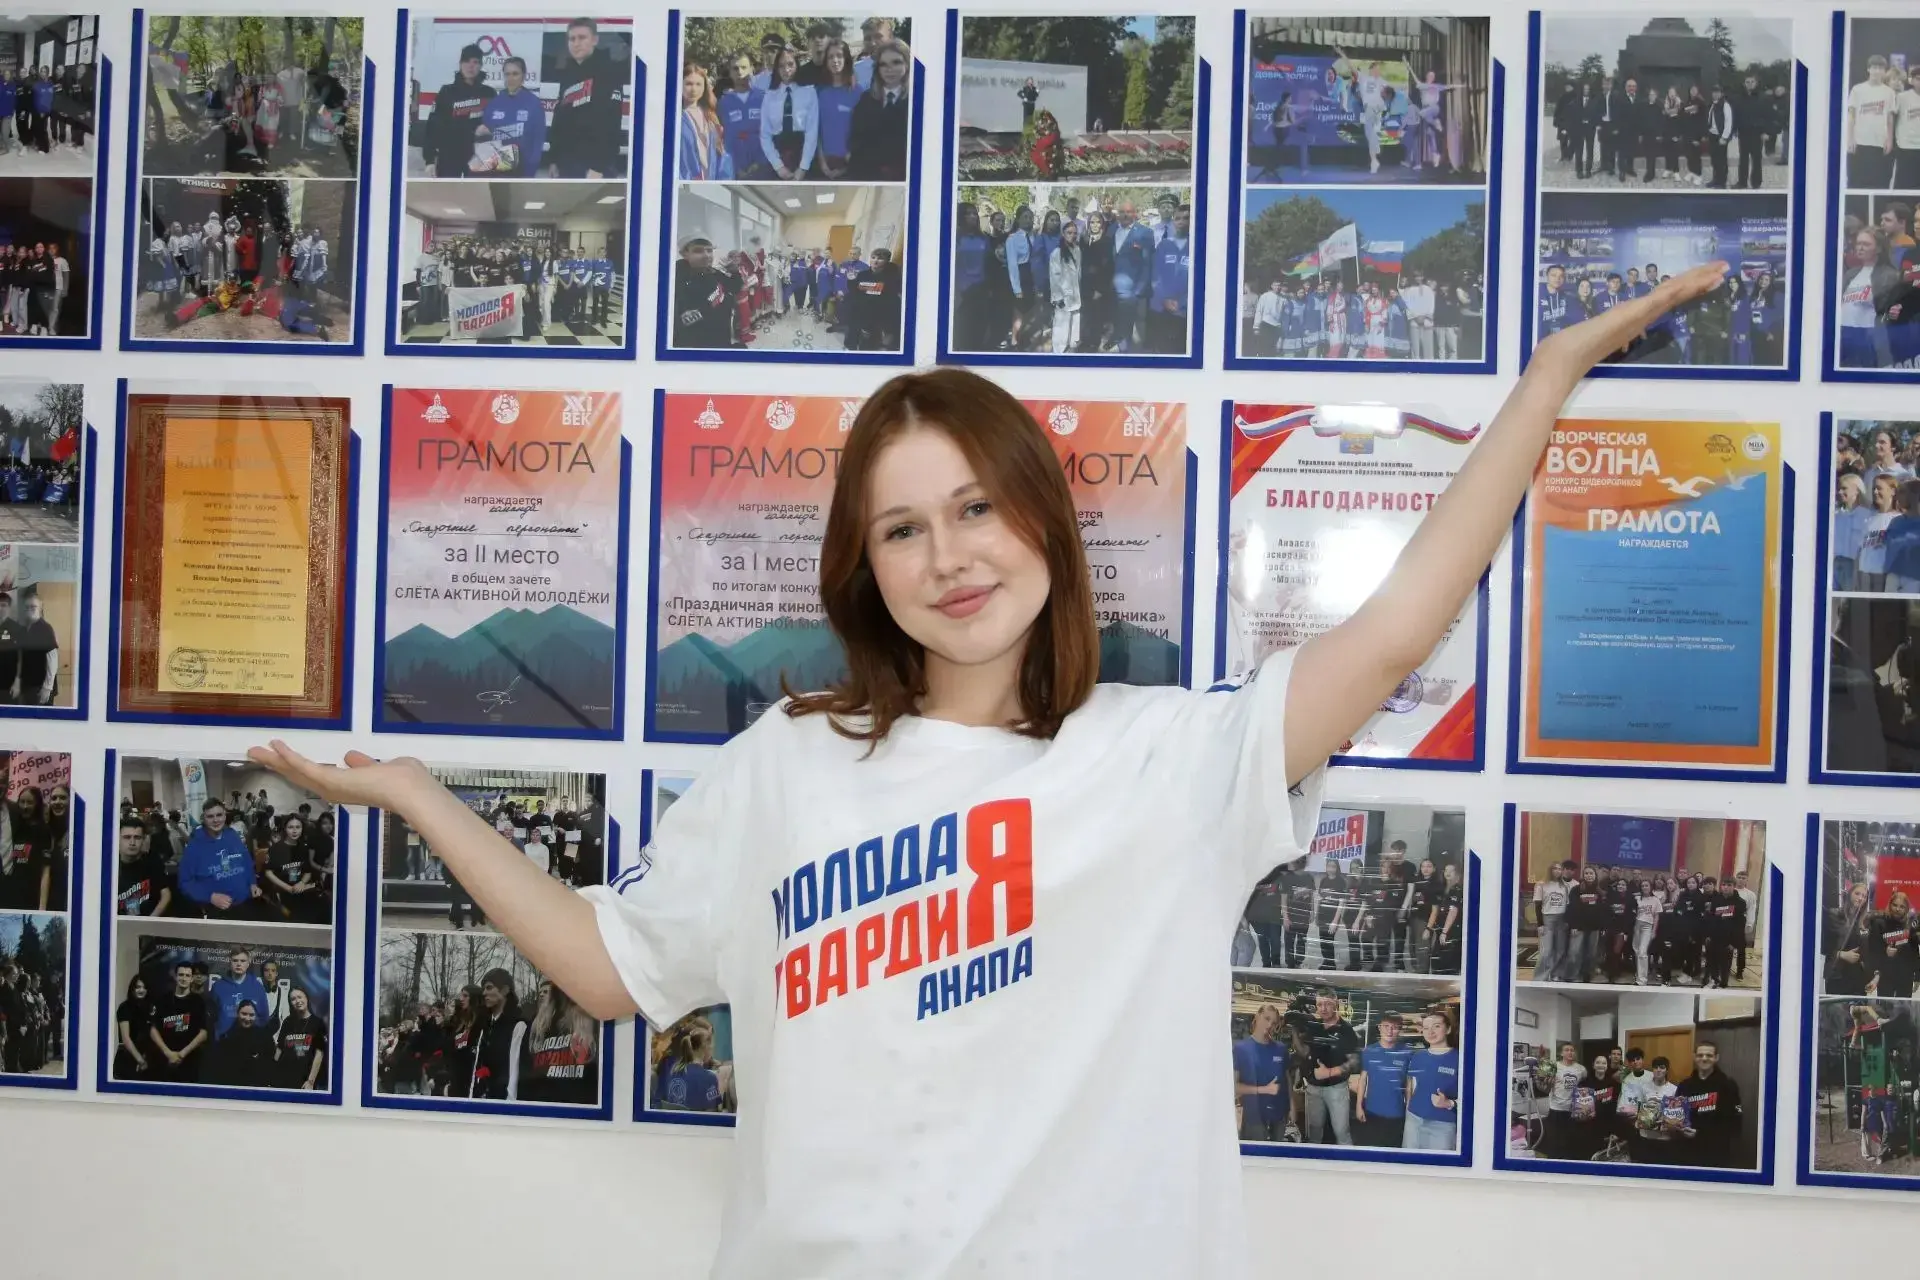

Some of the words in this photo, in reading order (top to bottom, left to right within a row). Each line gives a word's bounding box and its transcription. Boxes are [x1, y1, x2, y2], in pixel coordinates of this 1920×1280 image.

[177, 178, 210, 188] ЕТНИЙ
[211, 182, 227, 190] САД
[562, 411, 592, 426] ВЕК
[1123, 423, 1156, 437] ВЕК
[1550, 430, 1647, 446] ТВОРЧЕСКАЯ
[417, 438, 597, 474] ГРАМОТА
[690, 445, 844, 480] ГРАМОТ
[1546, 446, 1661, 476] ВОЛНА
[1063, 451, 1159, 486] МОТА
[1545, 476, 1580, 486] КОНКУРС
[1580, 478, 1642, 487] ВИДЕОРОЛИКОВ
[1545, 486, 1562, 494] ПРО
[1563, 487, 1589, 495] АНАПУ
[463, 495, 543, 506] награждается
[1266, 488, 1439, 512] БЛАГОДАРНОСТ
[738, 503, 819, 514] награждается
[1588, 508, 1721, 534] ГРАМОТА
[1618, 539, 1690, 550] НАГРАЖДАЕТСЯ
[444, 547, 468, 563] за
[494, 549, 560, 565] место
[721, 554, 745, 571] за
[765, 556, 820, 572] мест
[451, 574, 459, 583] в
[462, 573, 505, 585] общем
[395, 586, 440, 600] СЛЁТА
[443, 587, 521, 602] АКТИВНОЙ
[524, 589, 610, 605] МОЛОДЁЖИ
[712, 581, 728, 591] по
[731, 582, 777, 592] итогам
[780, 584, 818, 594] конку
[665, 596, 774, 612] «Праздничная
[1092, 592, 1125, 603] урса
[668, 613, 713, 627] СЛЁТА
[716, 615, 794, 630] АКТИВНОЙ
[1095, 611, 1166, 624] аздника»
[1276, 640, 1302, 648] рамк
[38, 767, 70, 783] добр
[1317, 814, 1364, 846] ОДАЯ
[1619, 837, 1643, 850] 20
[771, 797, 1034, 950] МОЛОДАЯ
[916, 936, 1034, 1021] АНАПА
[547, 1064, 584, 1078] АНАПА
